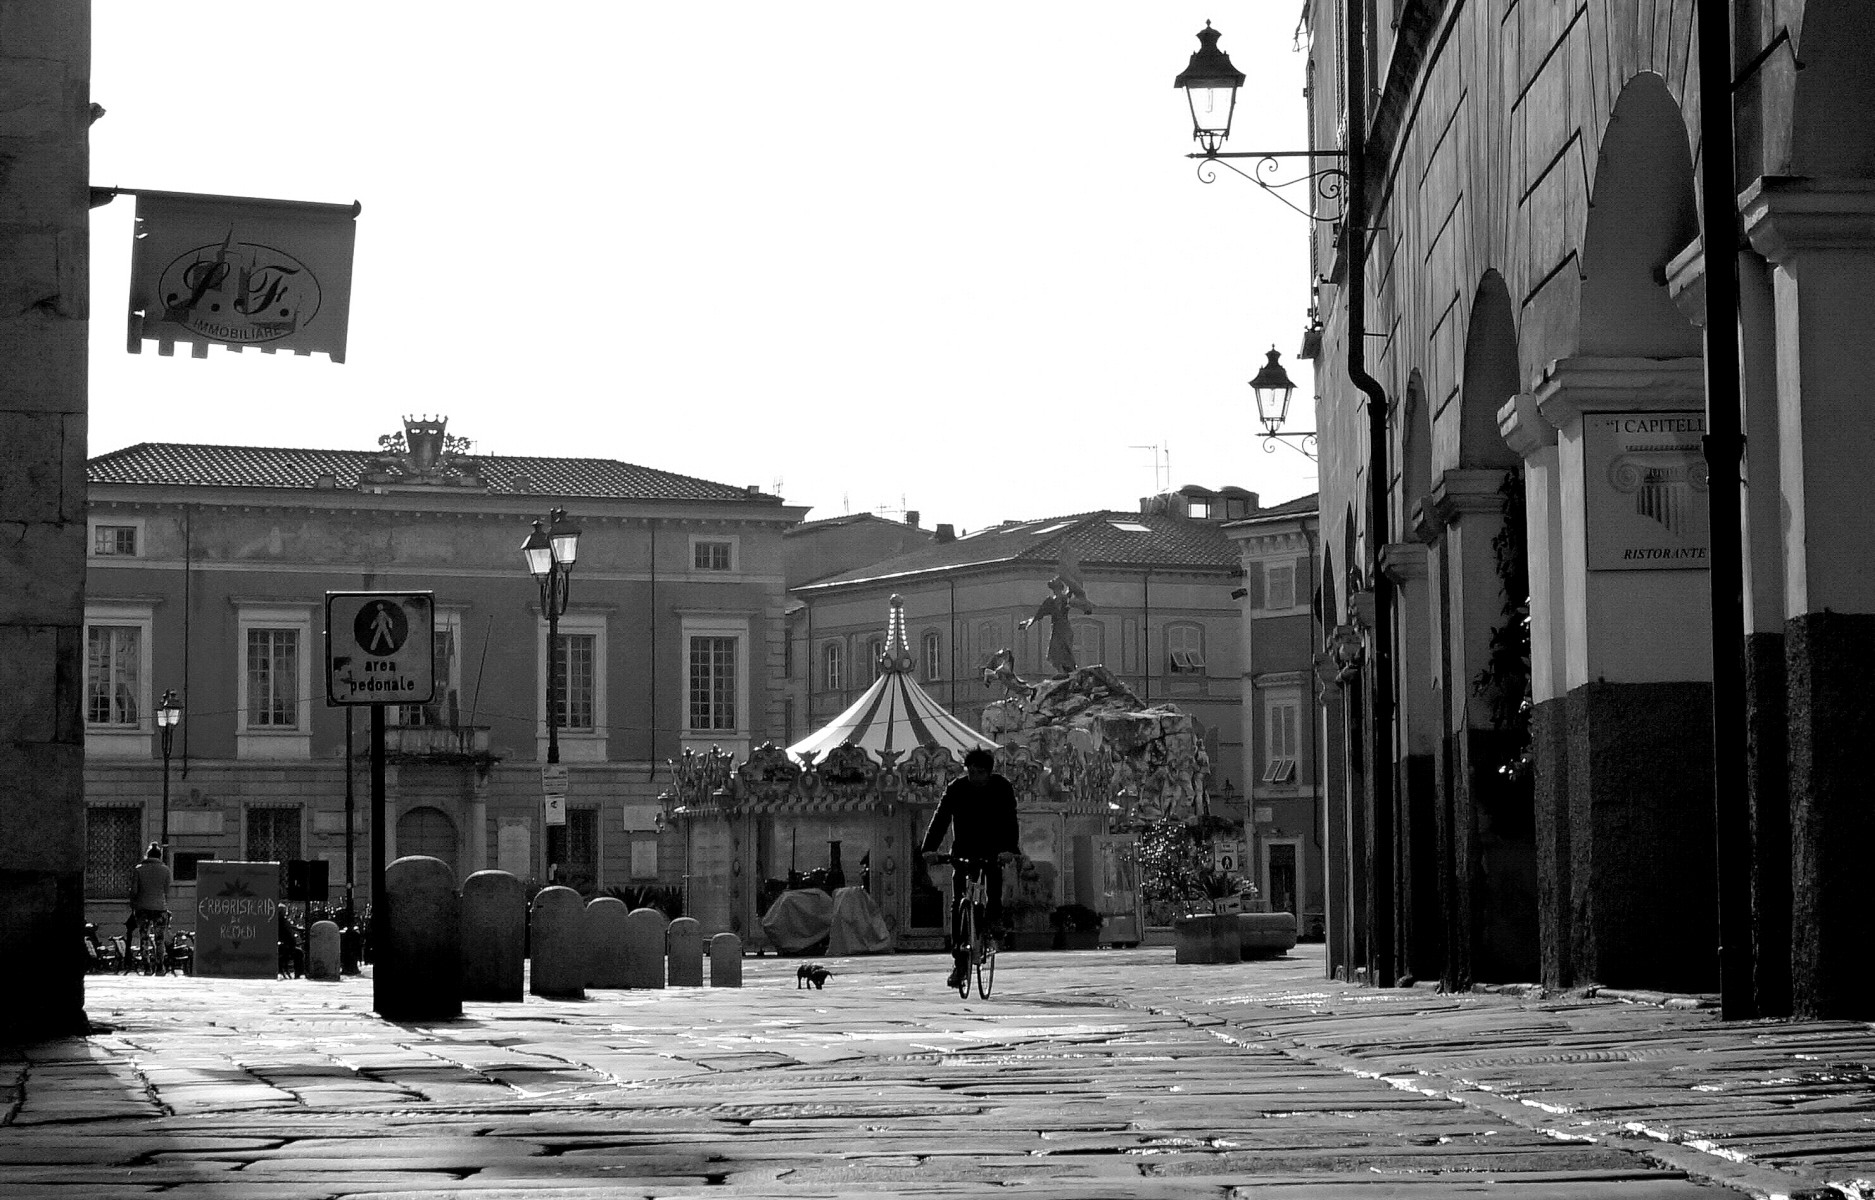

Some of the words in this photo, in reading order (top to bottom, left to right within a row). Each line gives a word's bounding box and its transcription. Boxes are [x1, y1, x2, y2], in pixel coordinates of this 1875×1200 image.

[193, 318, 282, 339] IMMOBILIARE
[1624, 547, 1707, 560] RISTORANTE
[365, 660, 396, 672] area
[350, 676, 415, 696] pedonale
[220, 924, 256, 939] REMEDI
